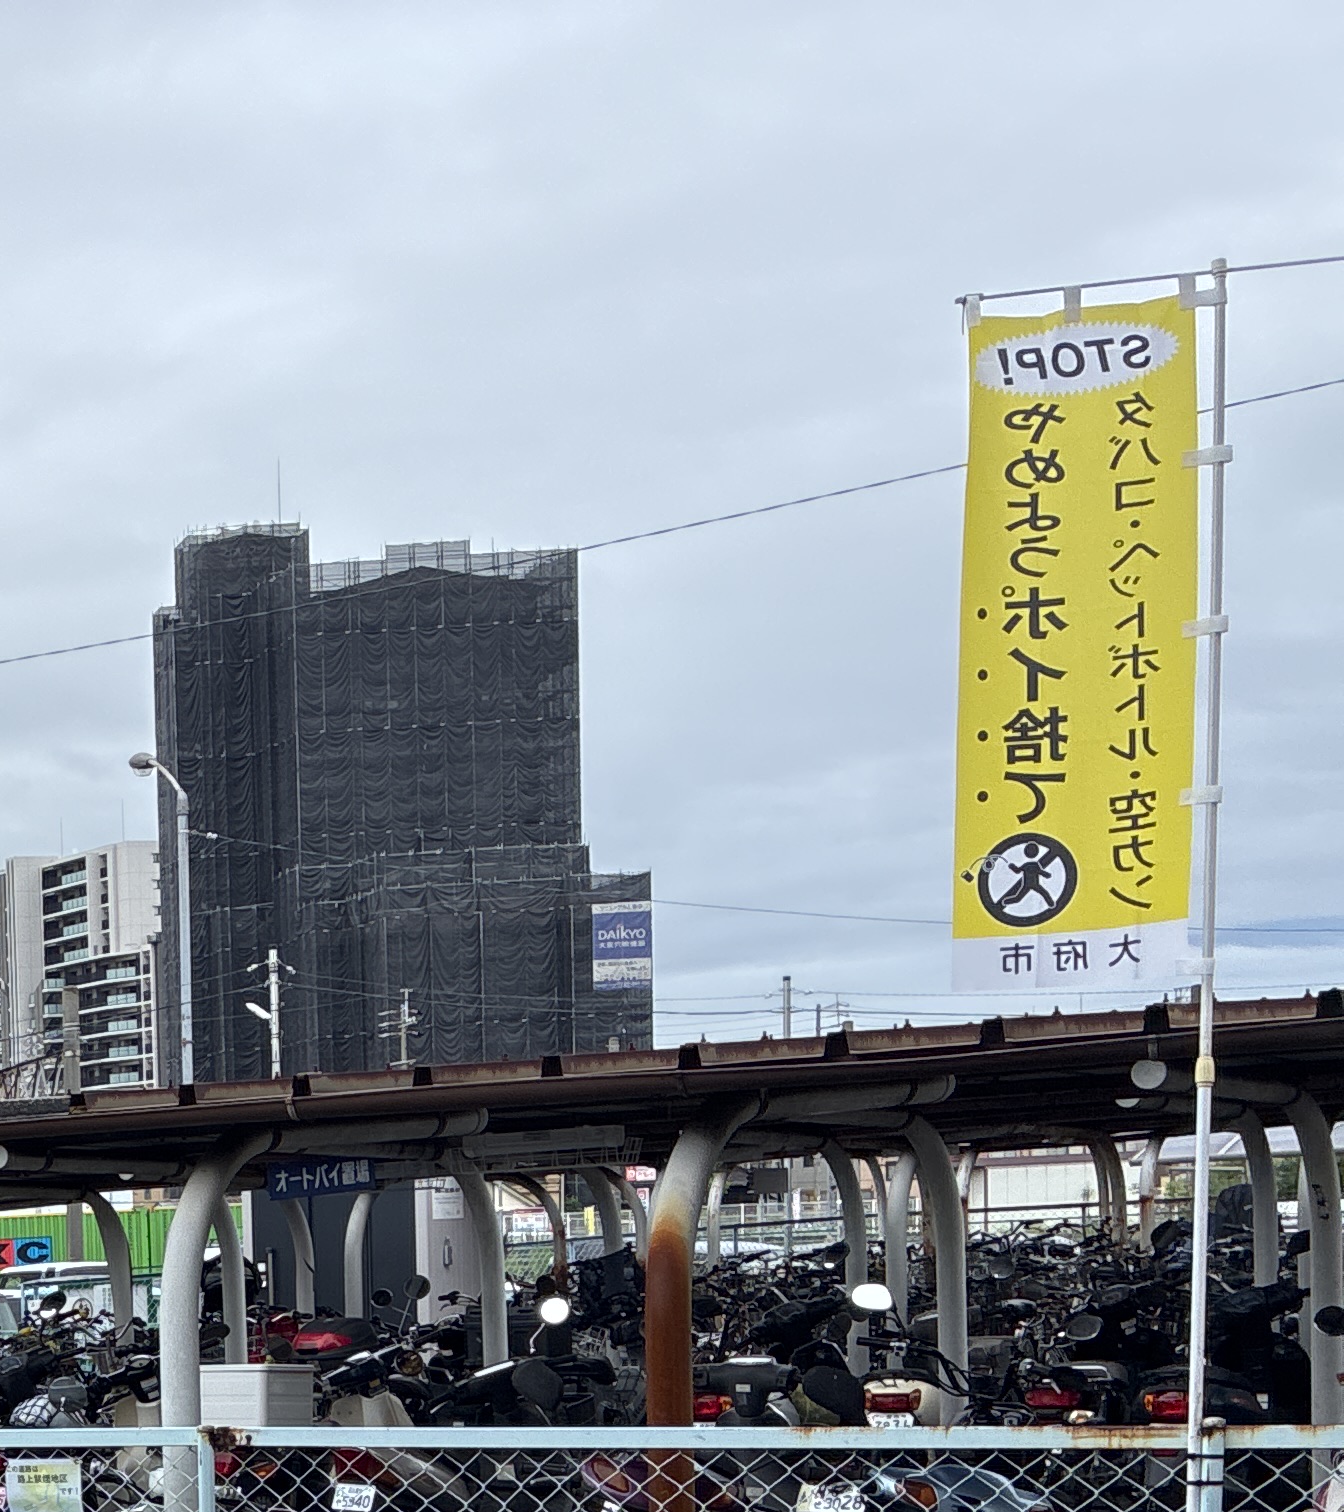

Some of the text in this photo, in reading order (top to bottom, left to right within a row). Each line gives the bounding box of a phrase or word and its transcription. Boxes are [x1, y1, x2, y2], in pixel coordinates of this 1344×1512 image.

[275, 1159, 370, 1193] オートバイ置場
